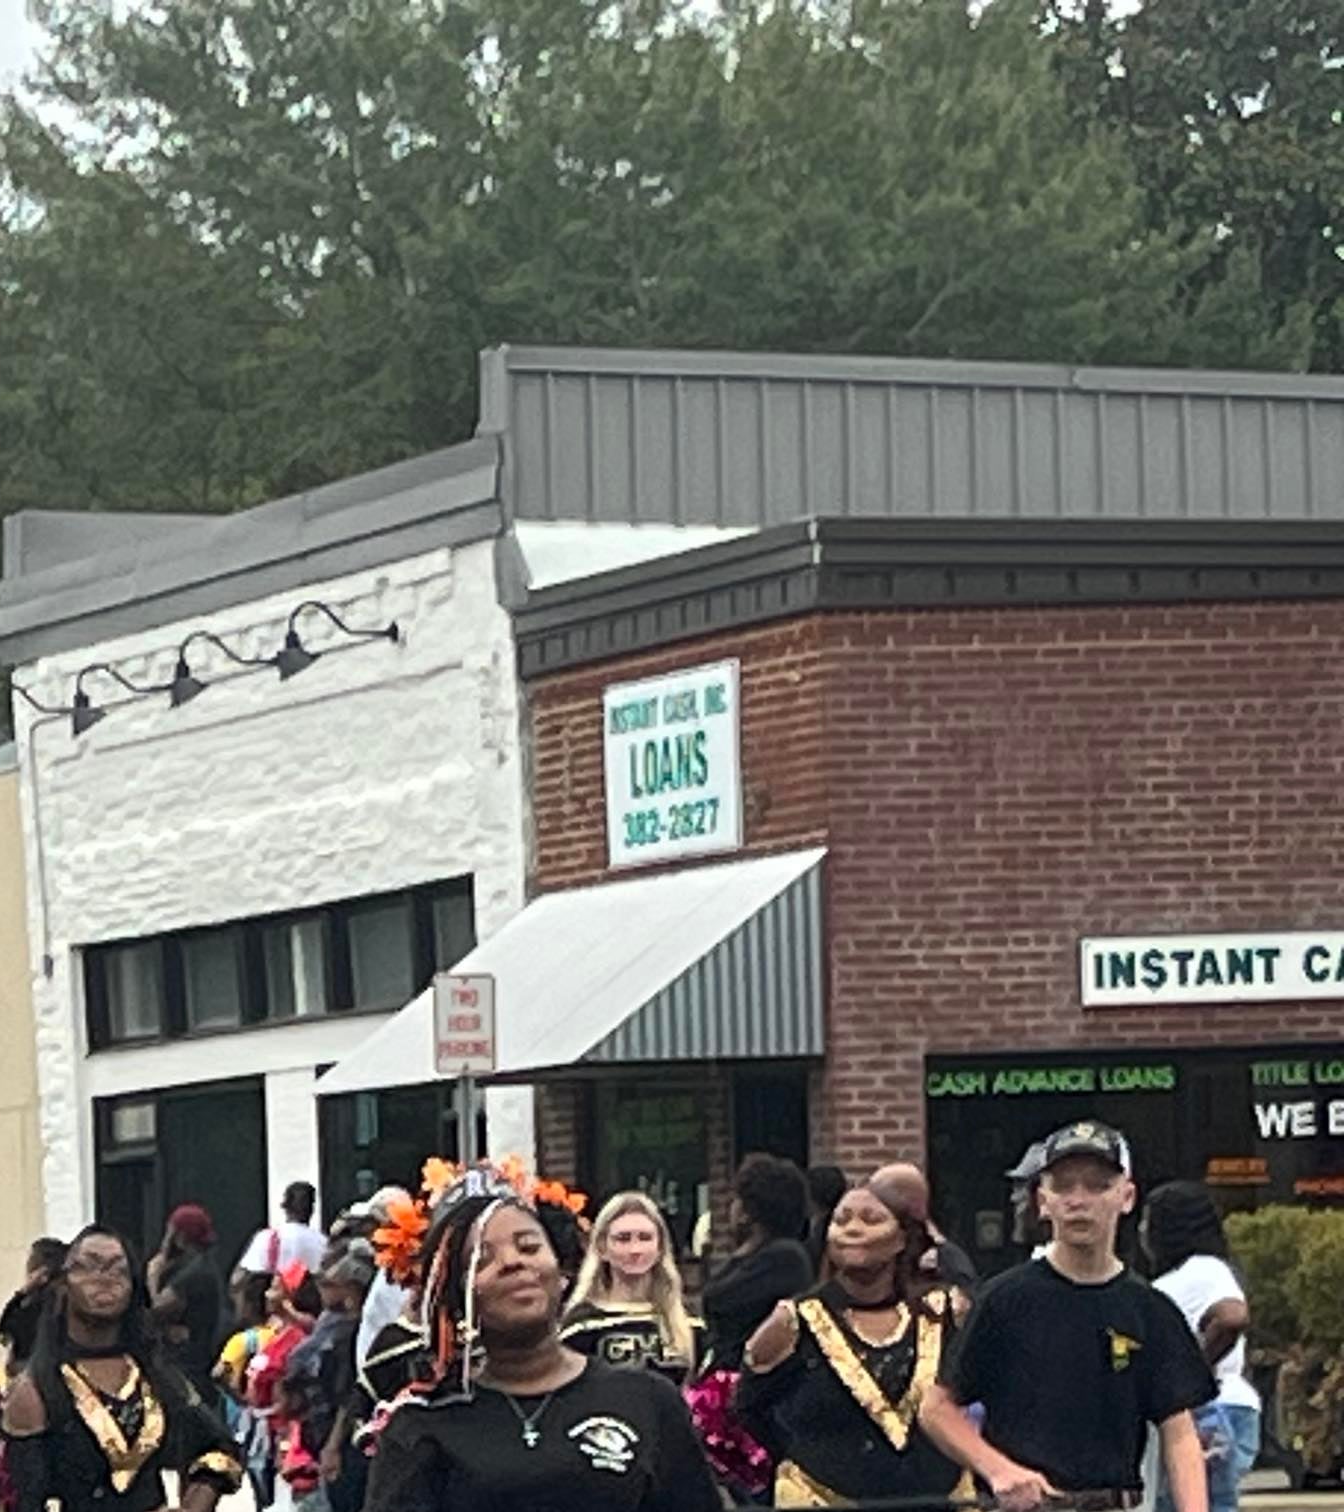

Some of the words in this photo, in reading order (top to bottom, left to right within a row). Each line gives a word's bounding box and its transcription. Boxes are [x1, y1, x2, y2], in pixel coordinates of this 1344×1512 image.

[628, 730, 708, 799] LOANS
[927, 1071, 988, 1097] CASH
[992, 1067, 1096, 1094] ADVANCE
[1100, 1065, 1175, 1092] LOANS
[1250, 1060, 1310, 1086] TITLE
[1254, 1100, 1318, 1139] WE
